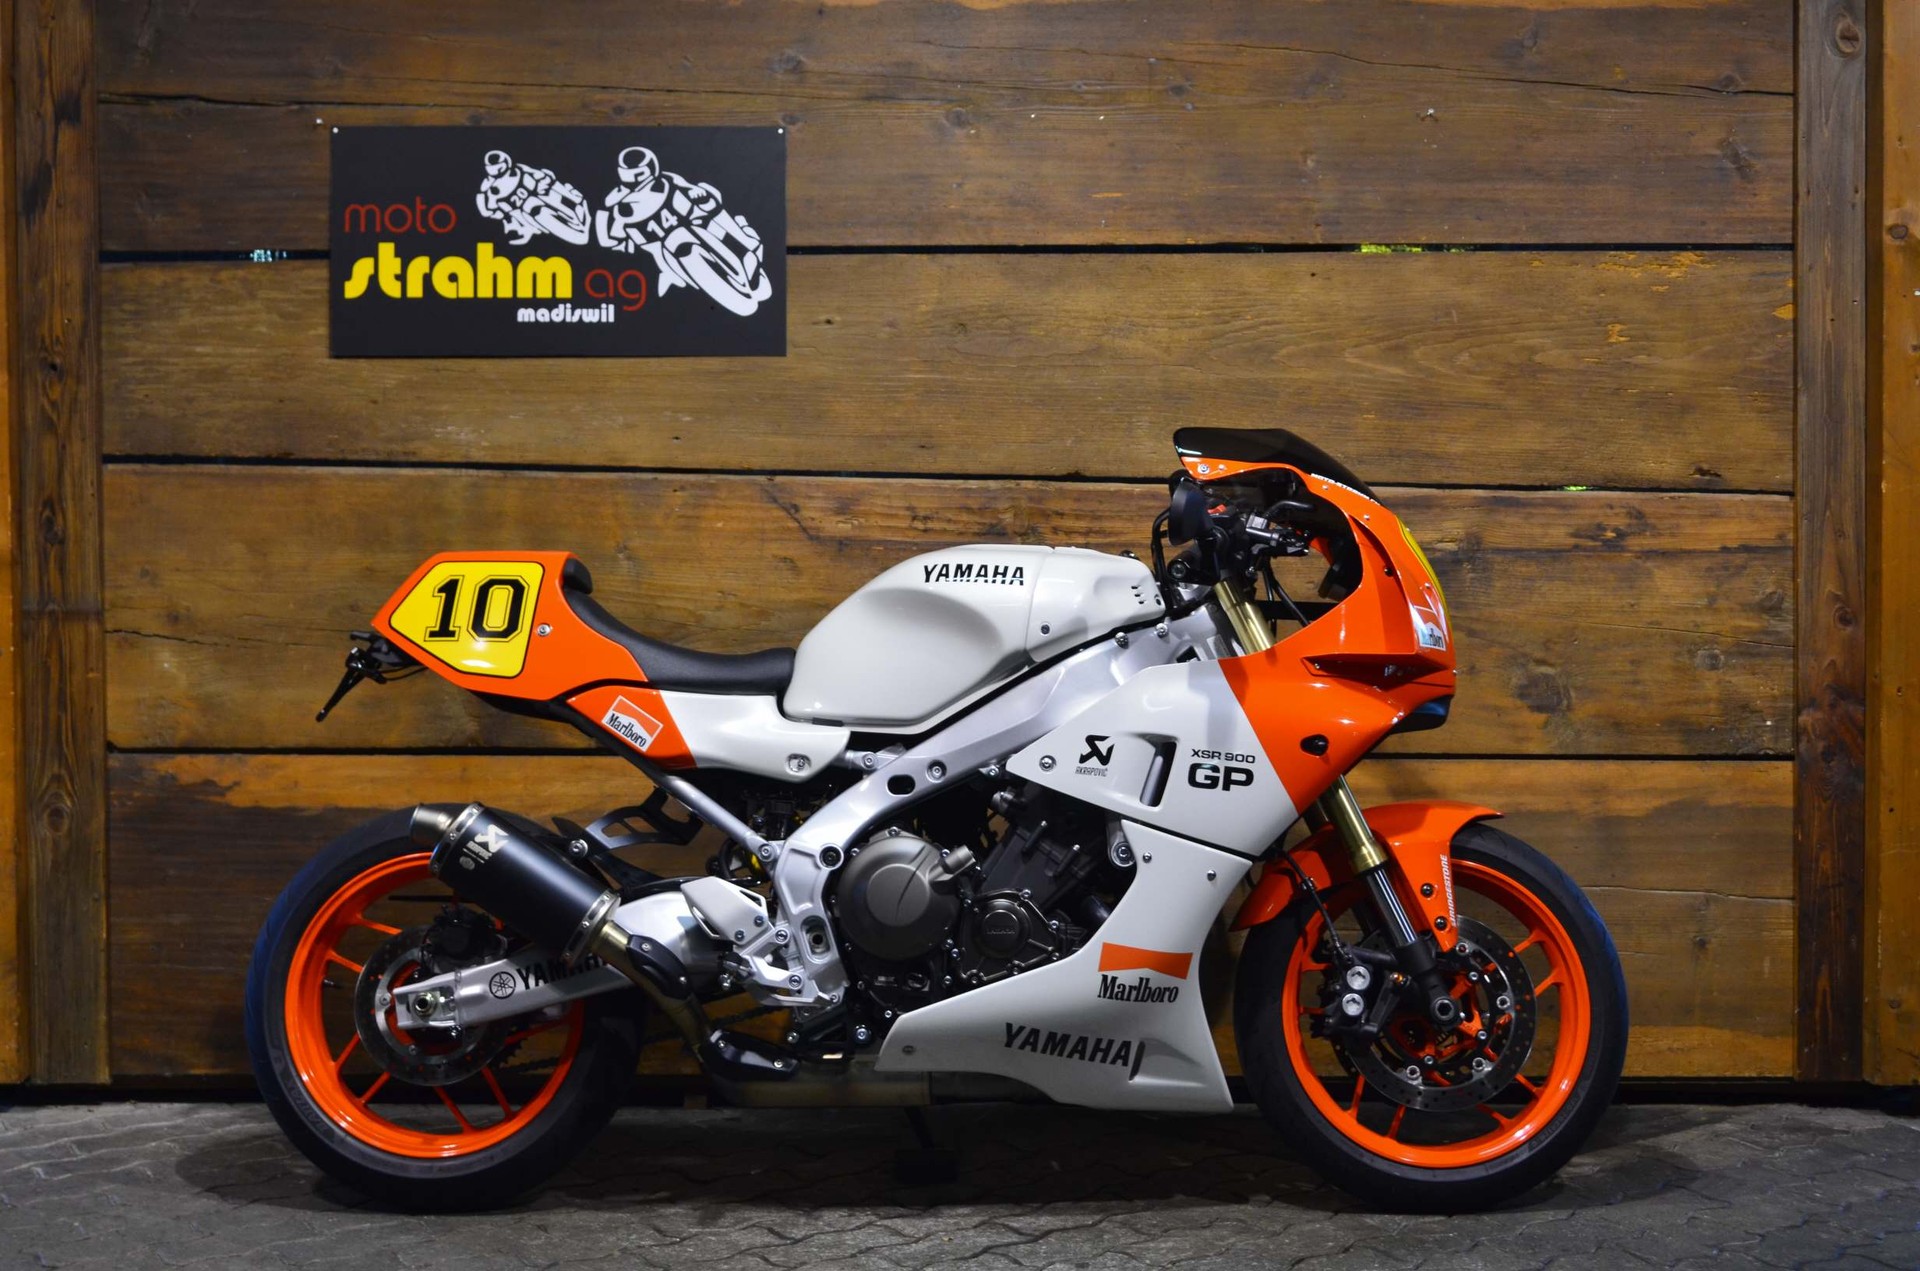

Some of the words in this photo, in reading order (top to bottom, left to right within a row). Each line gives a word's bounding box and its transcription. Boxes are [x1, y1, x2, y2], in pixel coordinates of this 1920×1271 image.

[344, 196, 456, 234] moto
[647, 212, 678, 239] 14
[344, 242, 572, 299] strahm
[584, 269, 647, 312] ag
[517, 303, 615, 323] madiswil
[923, 563, 1025, 586] YAMAHA
[424, 574, 529, 643] 10
[605, 713, 648, 749] Marlboro
[1191, 749, 1222, 761] XSR
[1224, 753, 1256, 764] 900
[1187, 763, 1254, 792] GP
[1097, 974, 1179, 1004] Marlboro
[1004, 1022, 1133, 1067] YAMAHA
